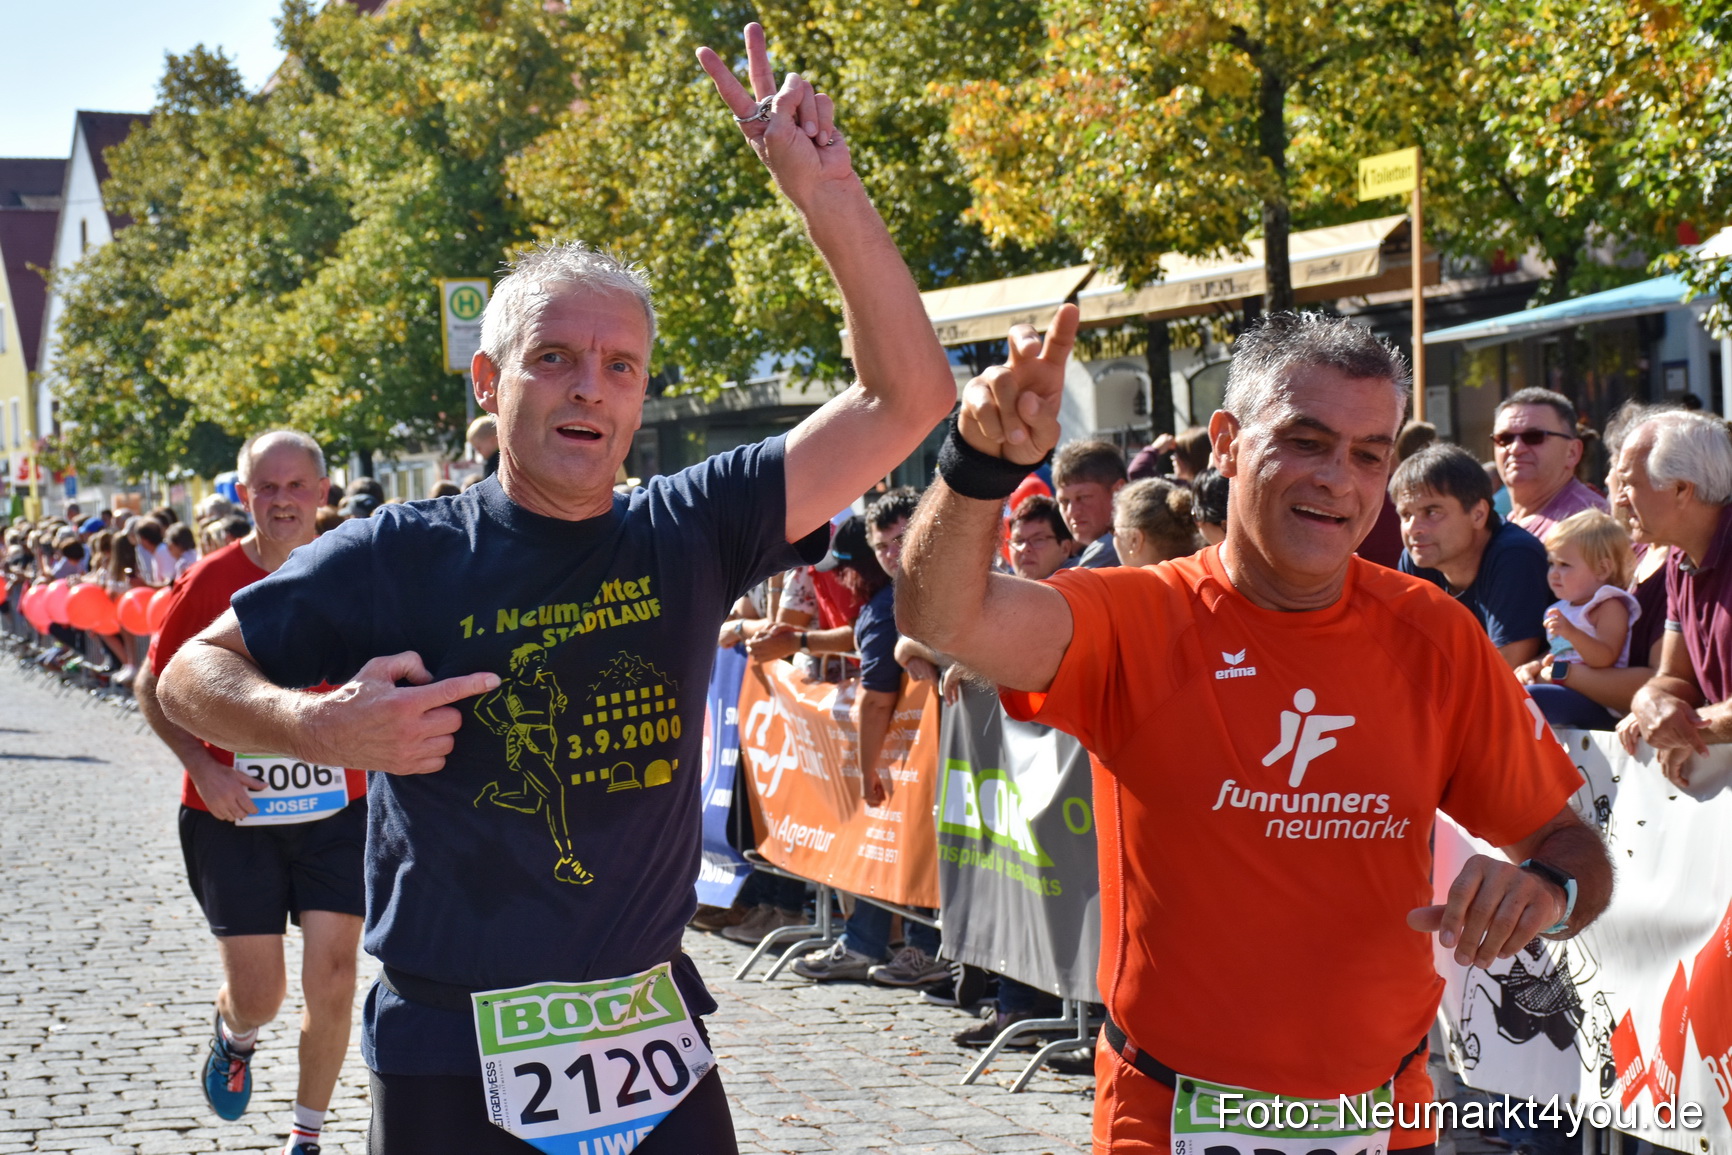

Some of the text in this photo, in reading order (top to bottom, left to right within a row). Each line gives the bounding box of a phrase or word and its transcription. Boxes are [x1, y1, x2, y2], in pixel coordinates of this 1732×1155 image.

[1370, 165, 1413, 186] Toiletten
[458, 295, 475, 312] H
[460, 614, 486, 640] 1.
[542, 598, 662, 648] STADTLAUF
[1215, 666, 1257, 680] erima
[567, 714, 682, 760] 3.9.2000
[247, 762, 333, 791] 3006
[265, 797, 318, 813] JOSEF
[1212, 779, 1390, 814] funrunners
[777, 814, 835, 853] Agentur
[1265, 815, 1411, 840] neumarkt
[496, 979, 666, 1042] BOCK
[513, 1039, 691, 1126] 2120
